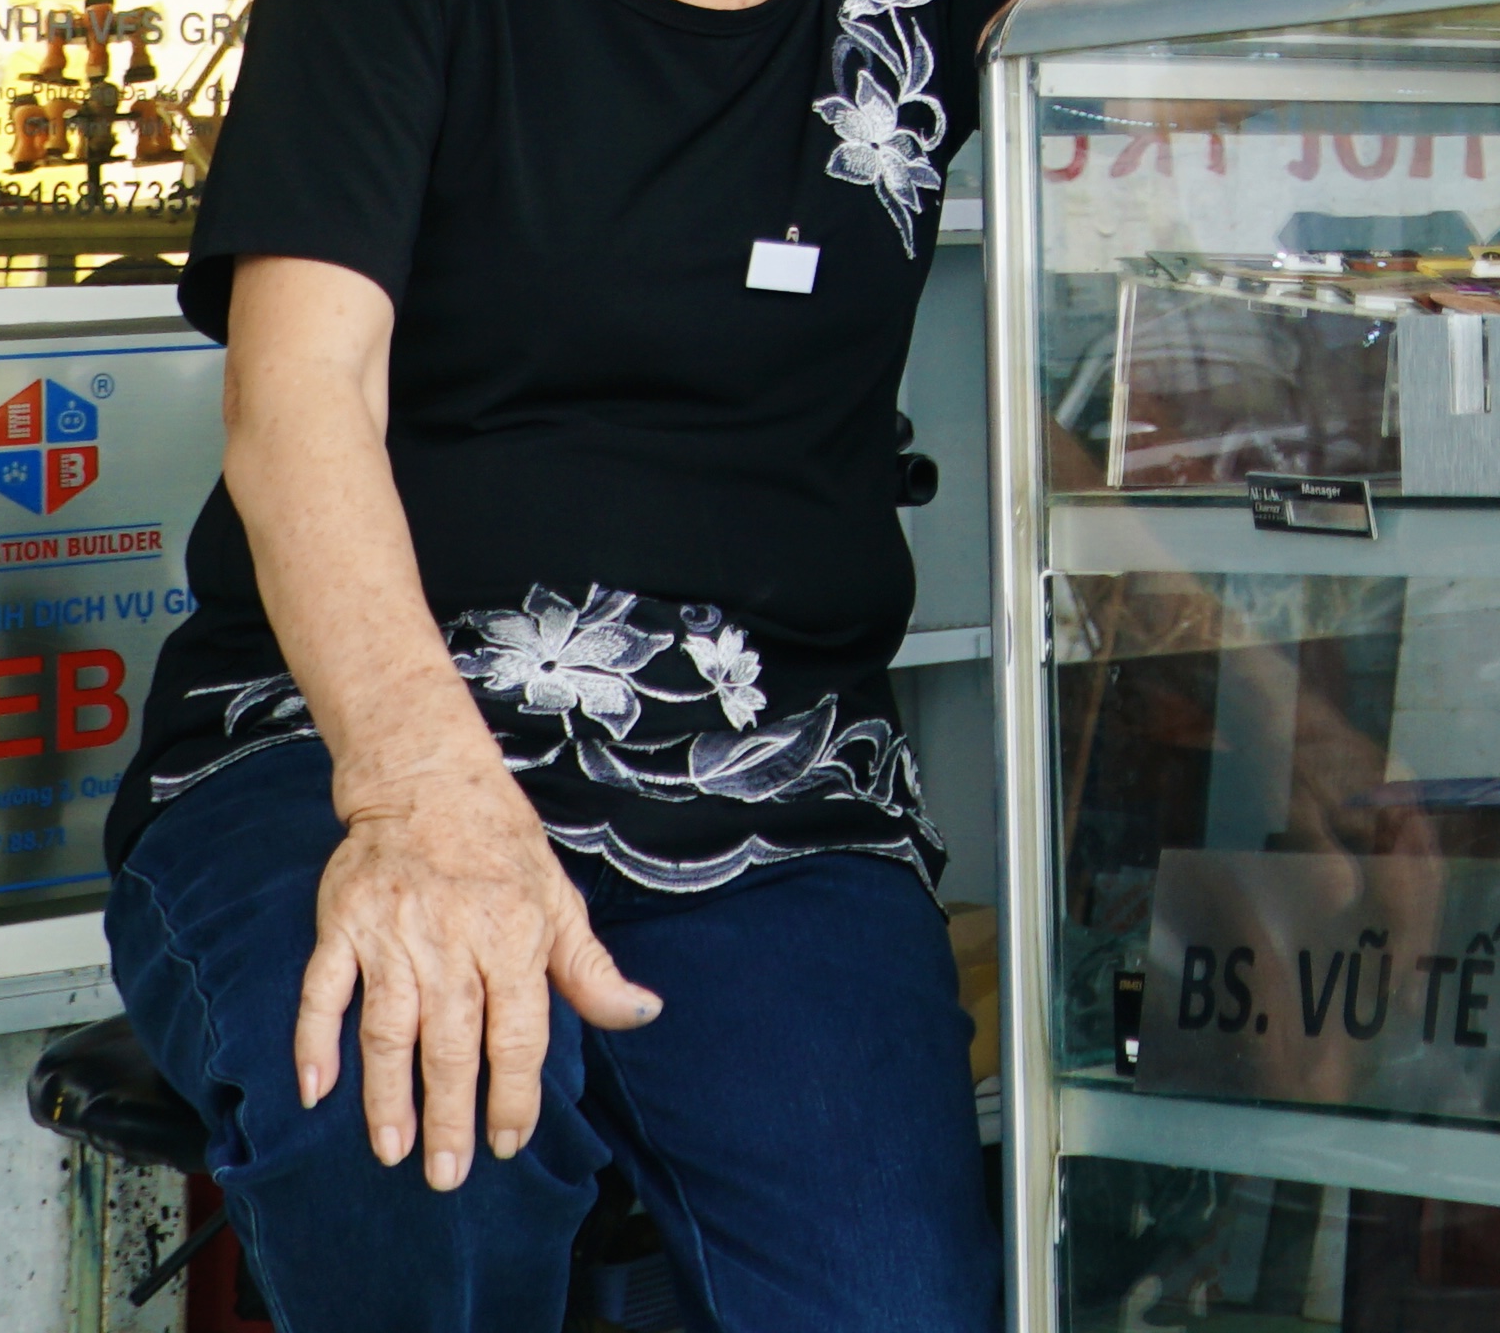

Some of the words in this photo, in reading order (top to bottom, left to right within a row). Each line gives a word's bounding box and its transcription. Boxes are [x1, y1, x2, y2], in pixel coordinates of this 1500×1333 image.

[1300, 482, 1341, 500] Manager
[67, 529, 164, 562] BUILDER
[1176, 943, 1270, 1034] BS.
[1297, 927, 1394, 1042] VŨ
